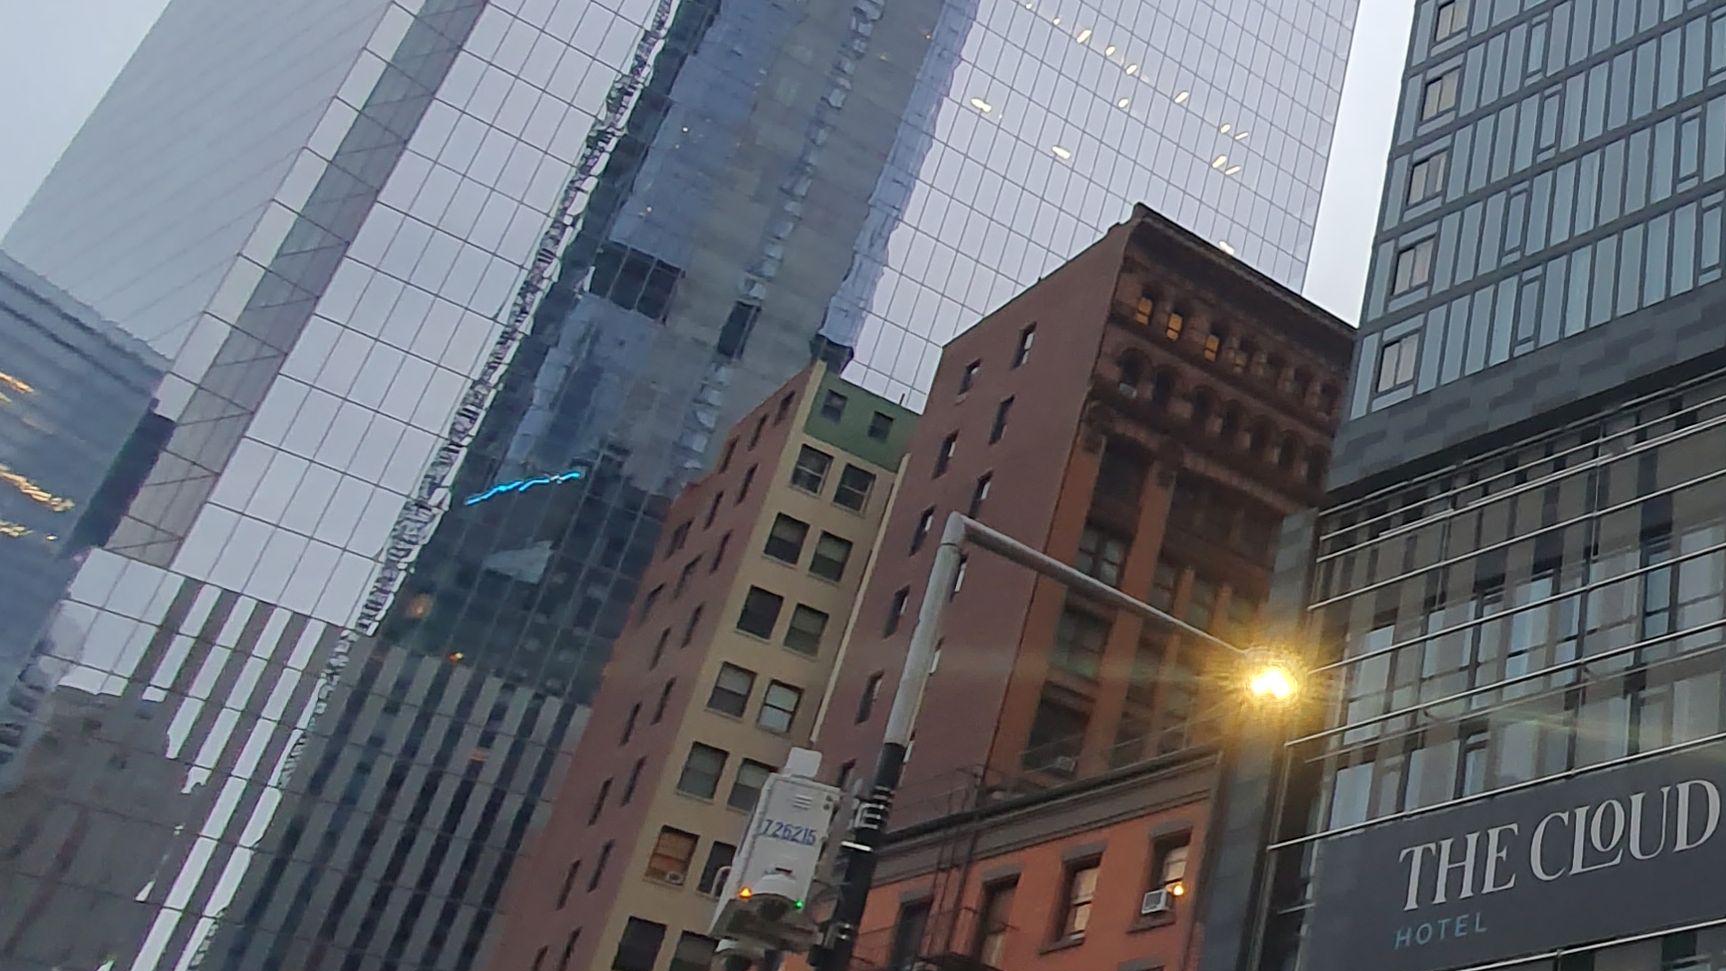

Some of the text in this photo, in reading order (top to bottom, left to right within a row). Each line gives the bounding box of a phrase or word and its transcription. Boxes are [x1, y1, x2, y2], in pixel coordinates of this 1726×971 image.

[1399, 823, 1519, 911] THE
[1529, 778, 1722, 882] CLOUD
[1393, 912, 1488, 952] HOTEL
